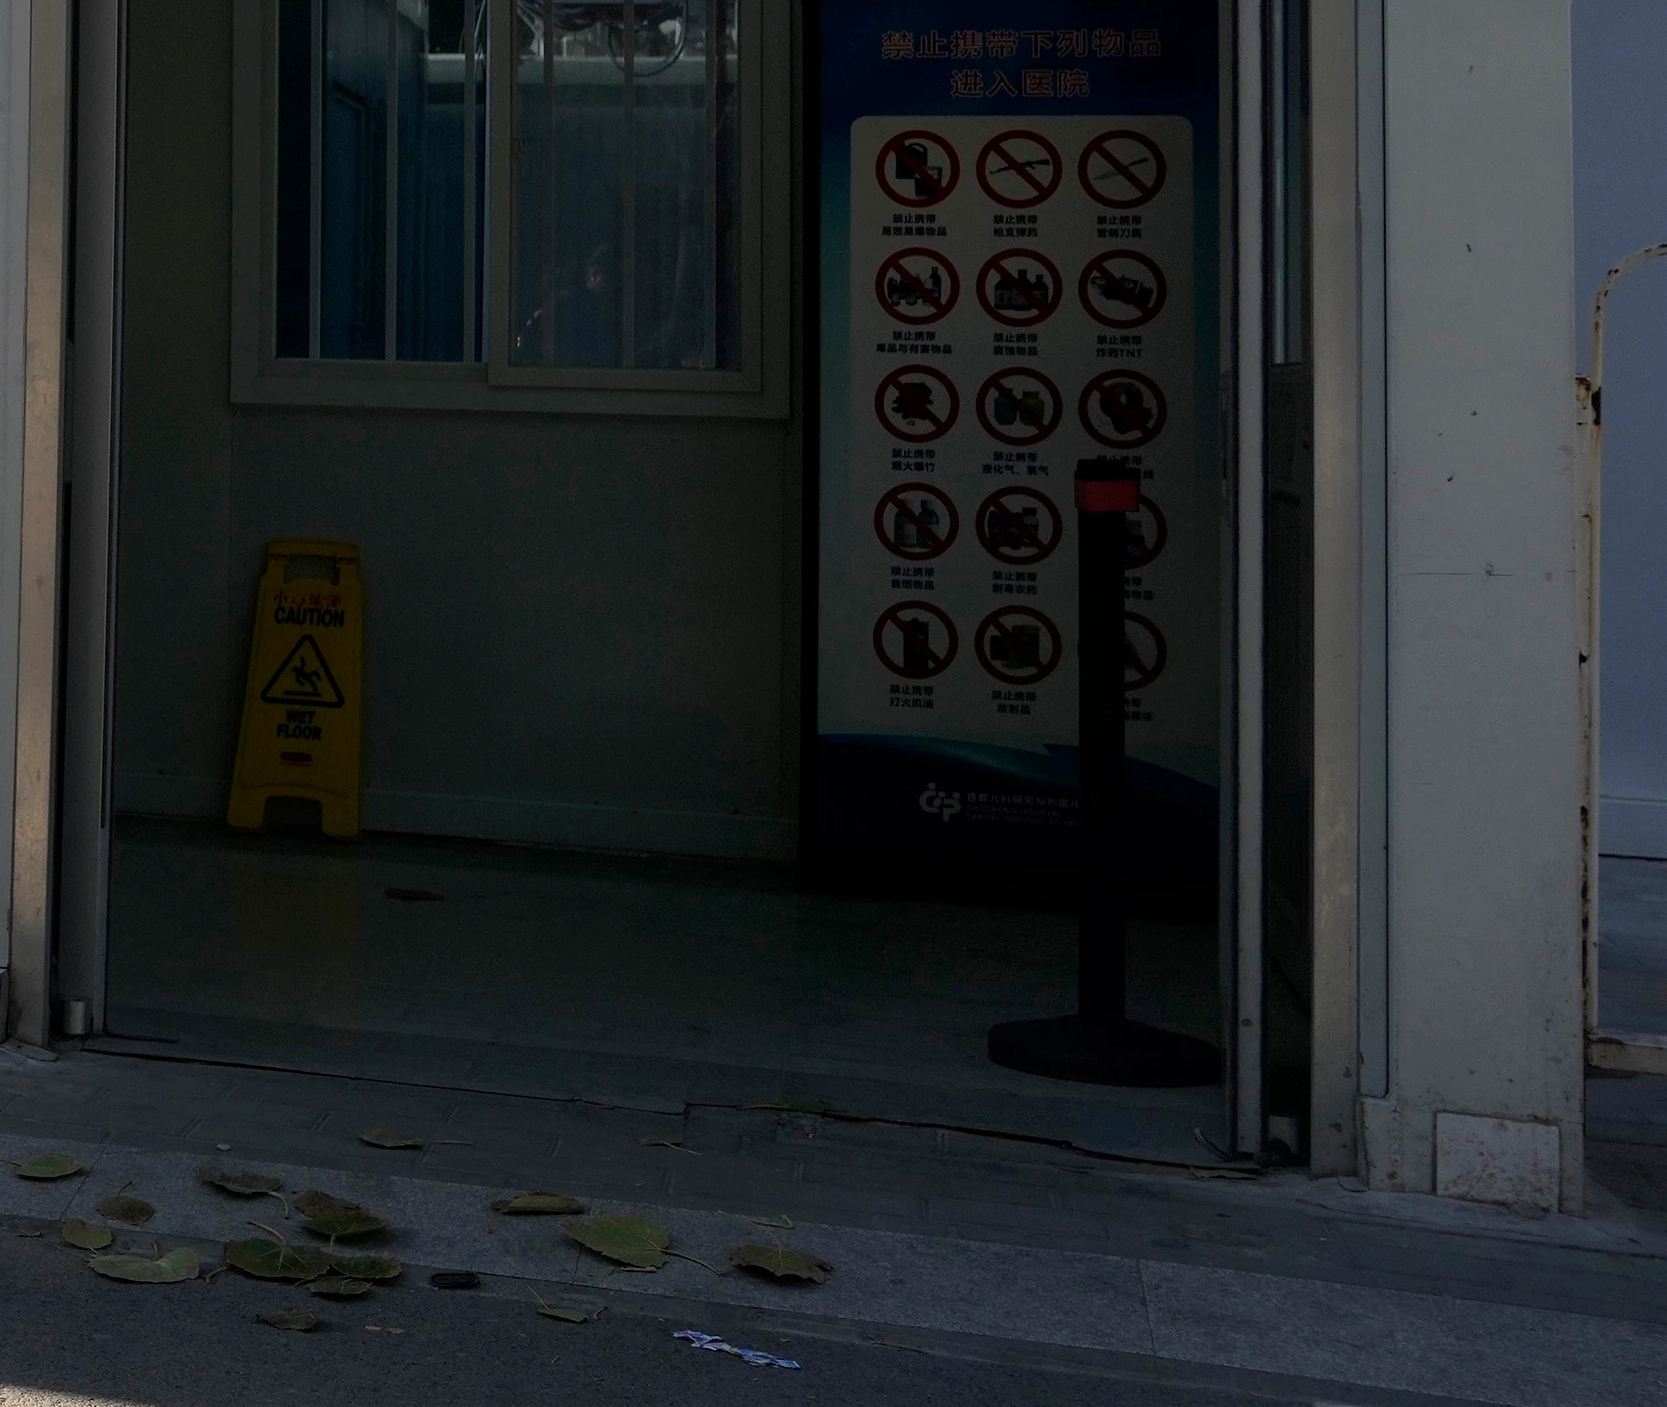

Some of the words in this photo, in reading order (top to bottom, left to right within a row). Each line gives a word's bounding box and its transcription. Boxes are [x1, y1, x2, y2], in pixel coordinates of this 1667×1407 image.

[882, 29, 1161, 59] 禁止携带下列物品
[951, 69, 1089, 99] 进入医院
[274, 606, 345, 628] CAUTION
[286, 709, 316, 724] WET
[276, 723, 322, 741] FLOOR
